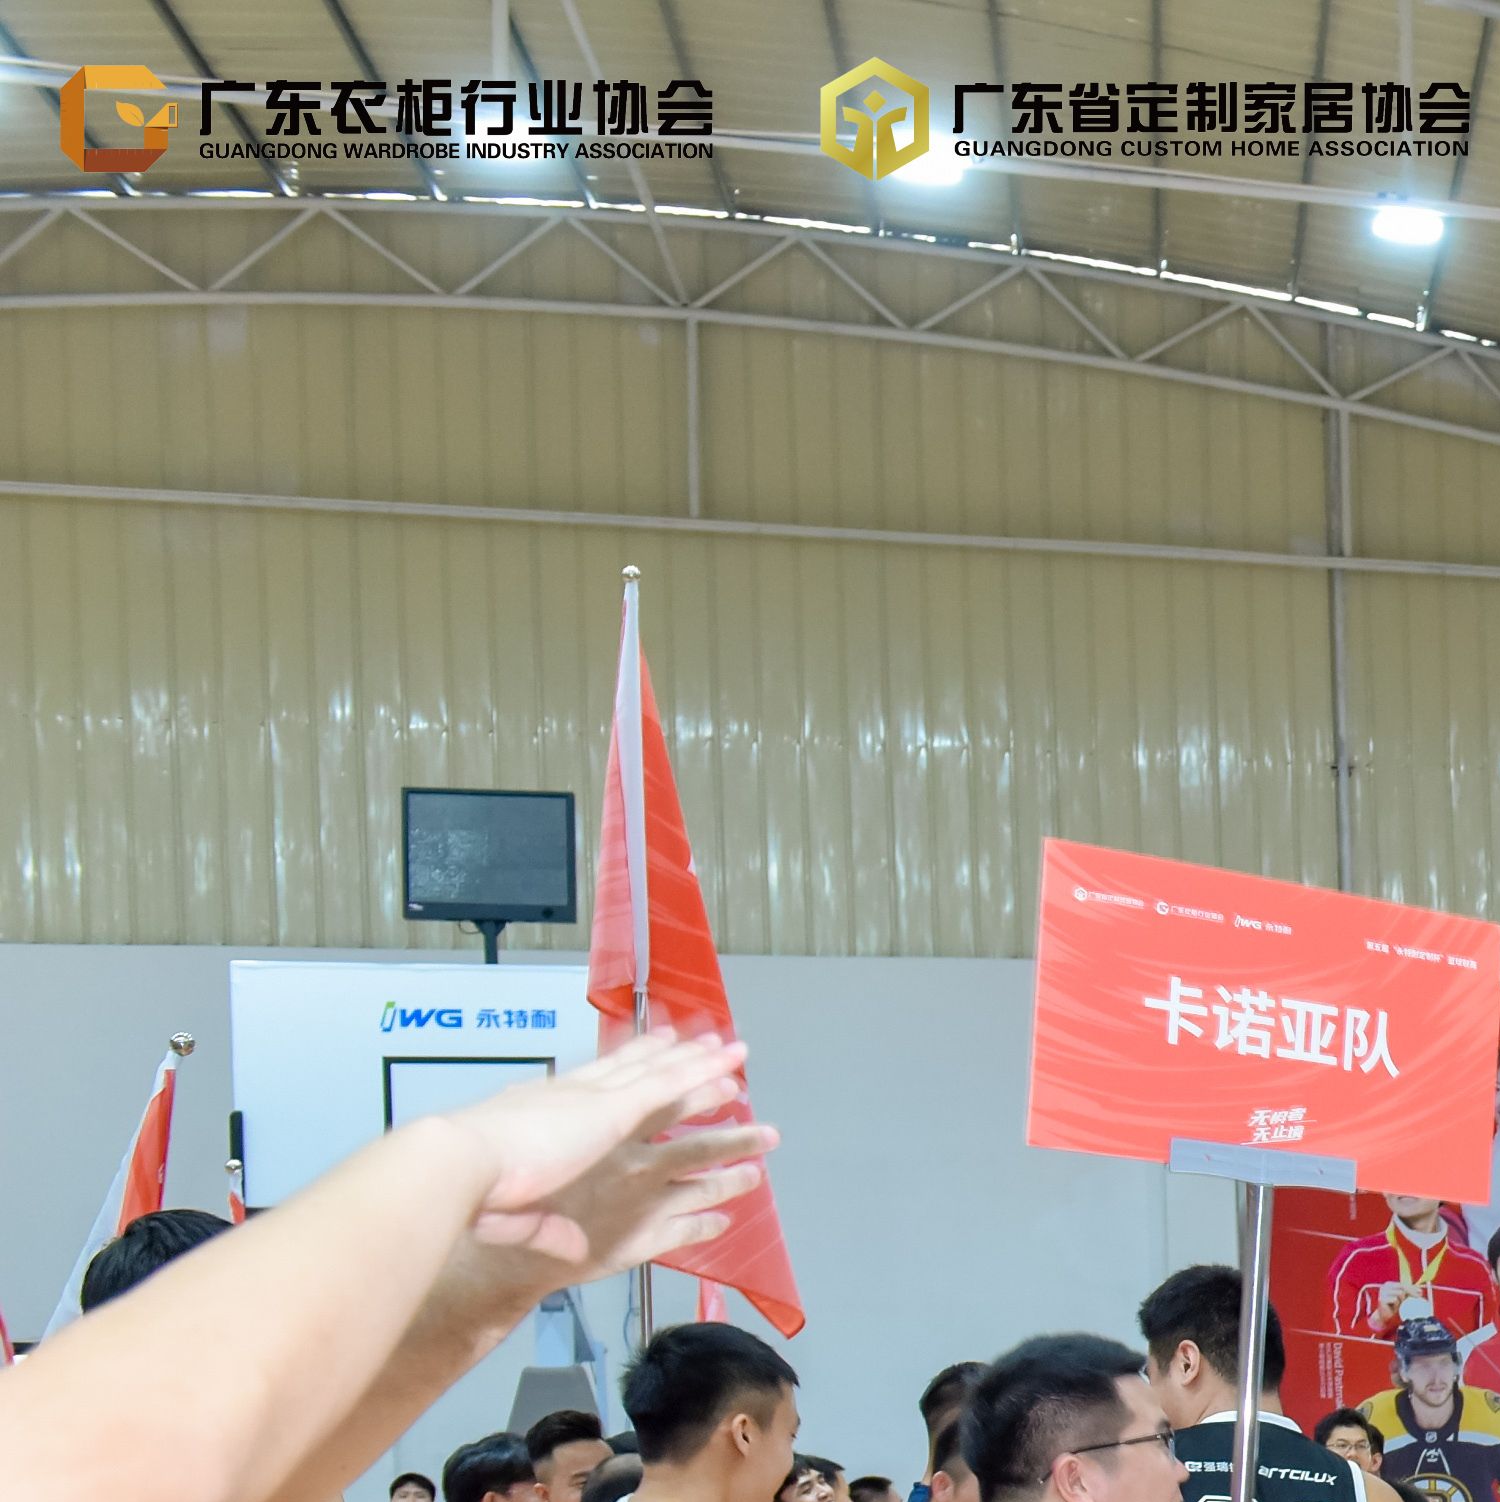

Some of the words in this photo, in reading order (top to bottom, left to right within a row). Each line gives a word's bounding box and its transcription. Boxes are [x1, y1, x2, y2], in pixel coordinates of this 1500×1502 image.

[475, 1008, 557, 1030] 永特耐
[1144, 976, 1400, 1080] 卡诺亚队
[1248, 1106, 1307, 1128] 无惧者
[1252, 1123, 1305, 1142] 无止境
